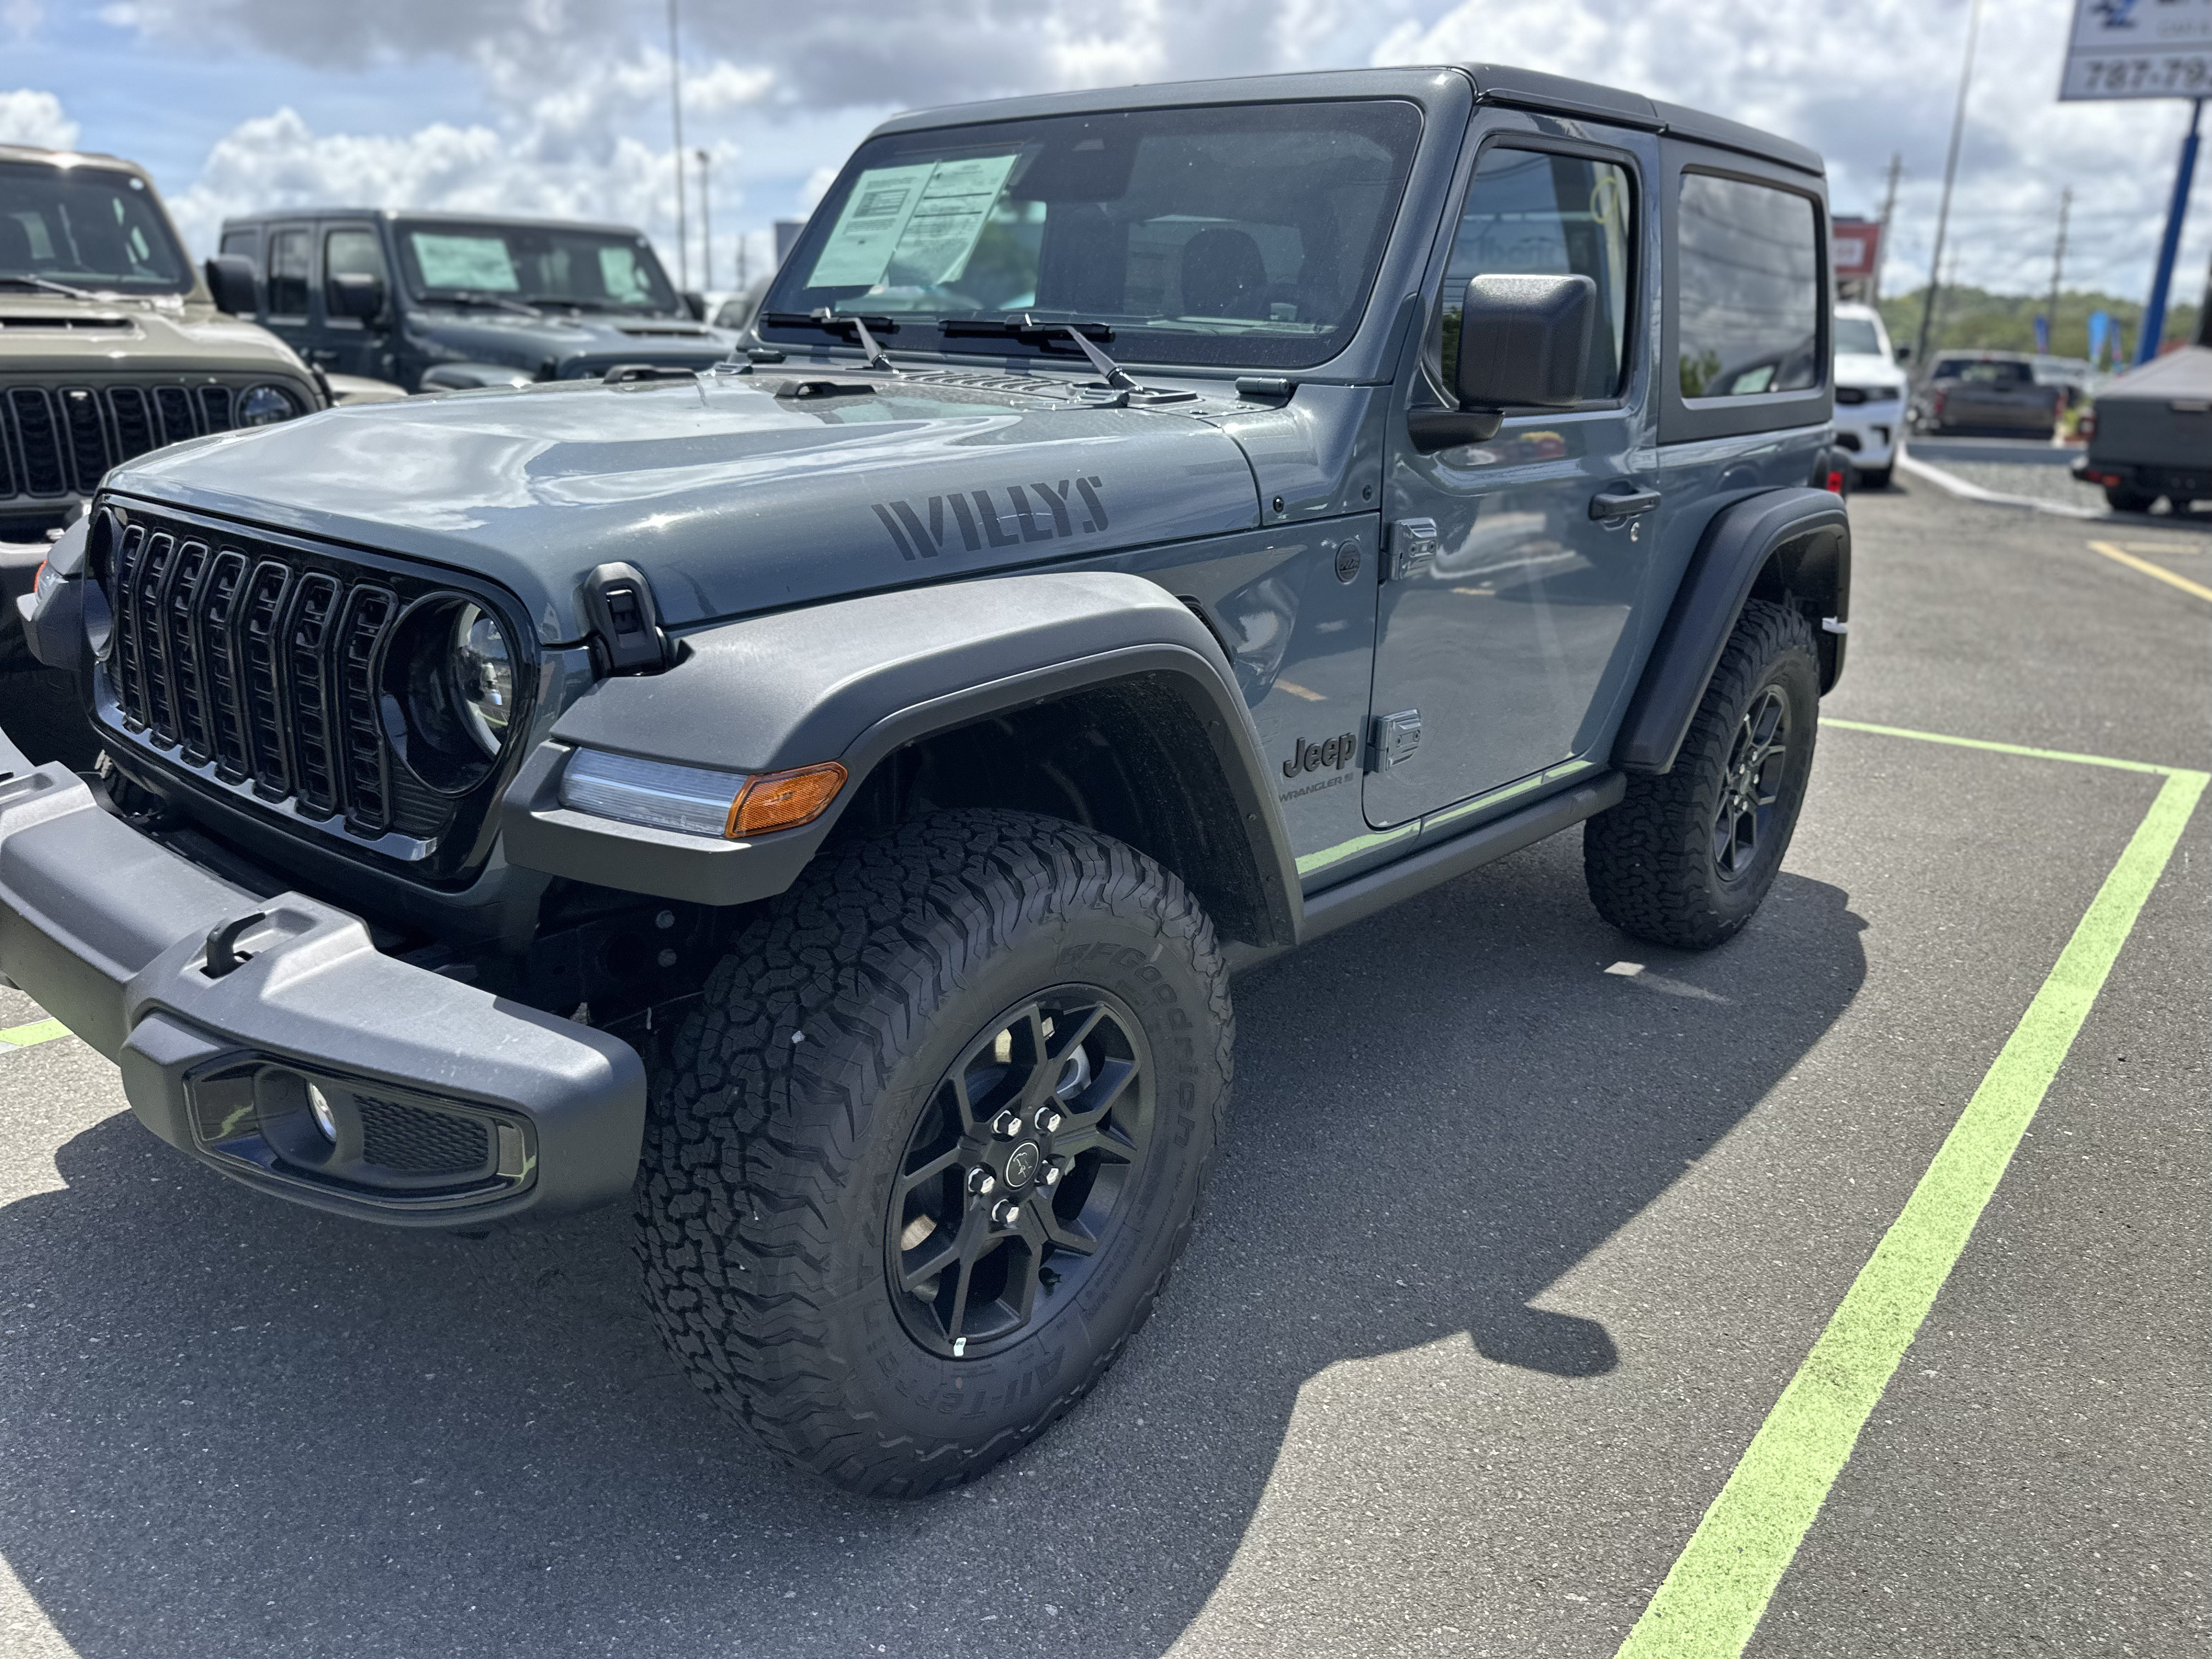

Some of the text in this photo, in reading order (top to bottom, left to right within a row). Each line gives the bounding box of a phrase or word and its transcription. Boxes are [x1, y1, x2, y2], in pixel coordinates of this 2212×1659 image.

[2086, 57, 2212, 89] 787-79
[871, 476, 1109, 561] WILLYS
[1283, 732, 1357, 777] Jeep
[1279, 776, 1342, 802] WRANGLER
